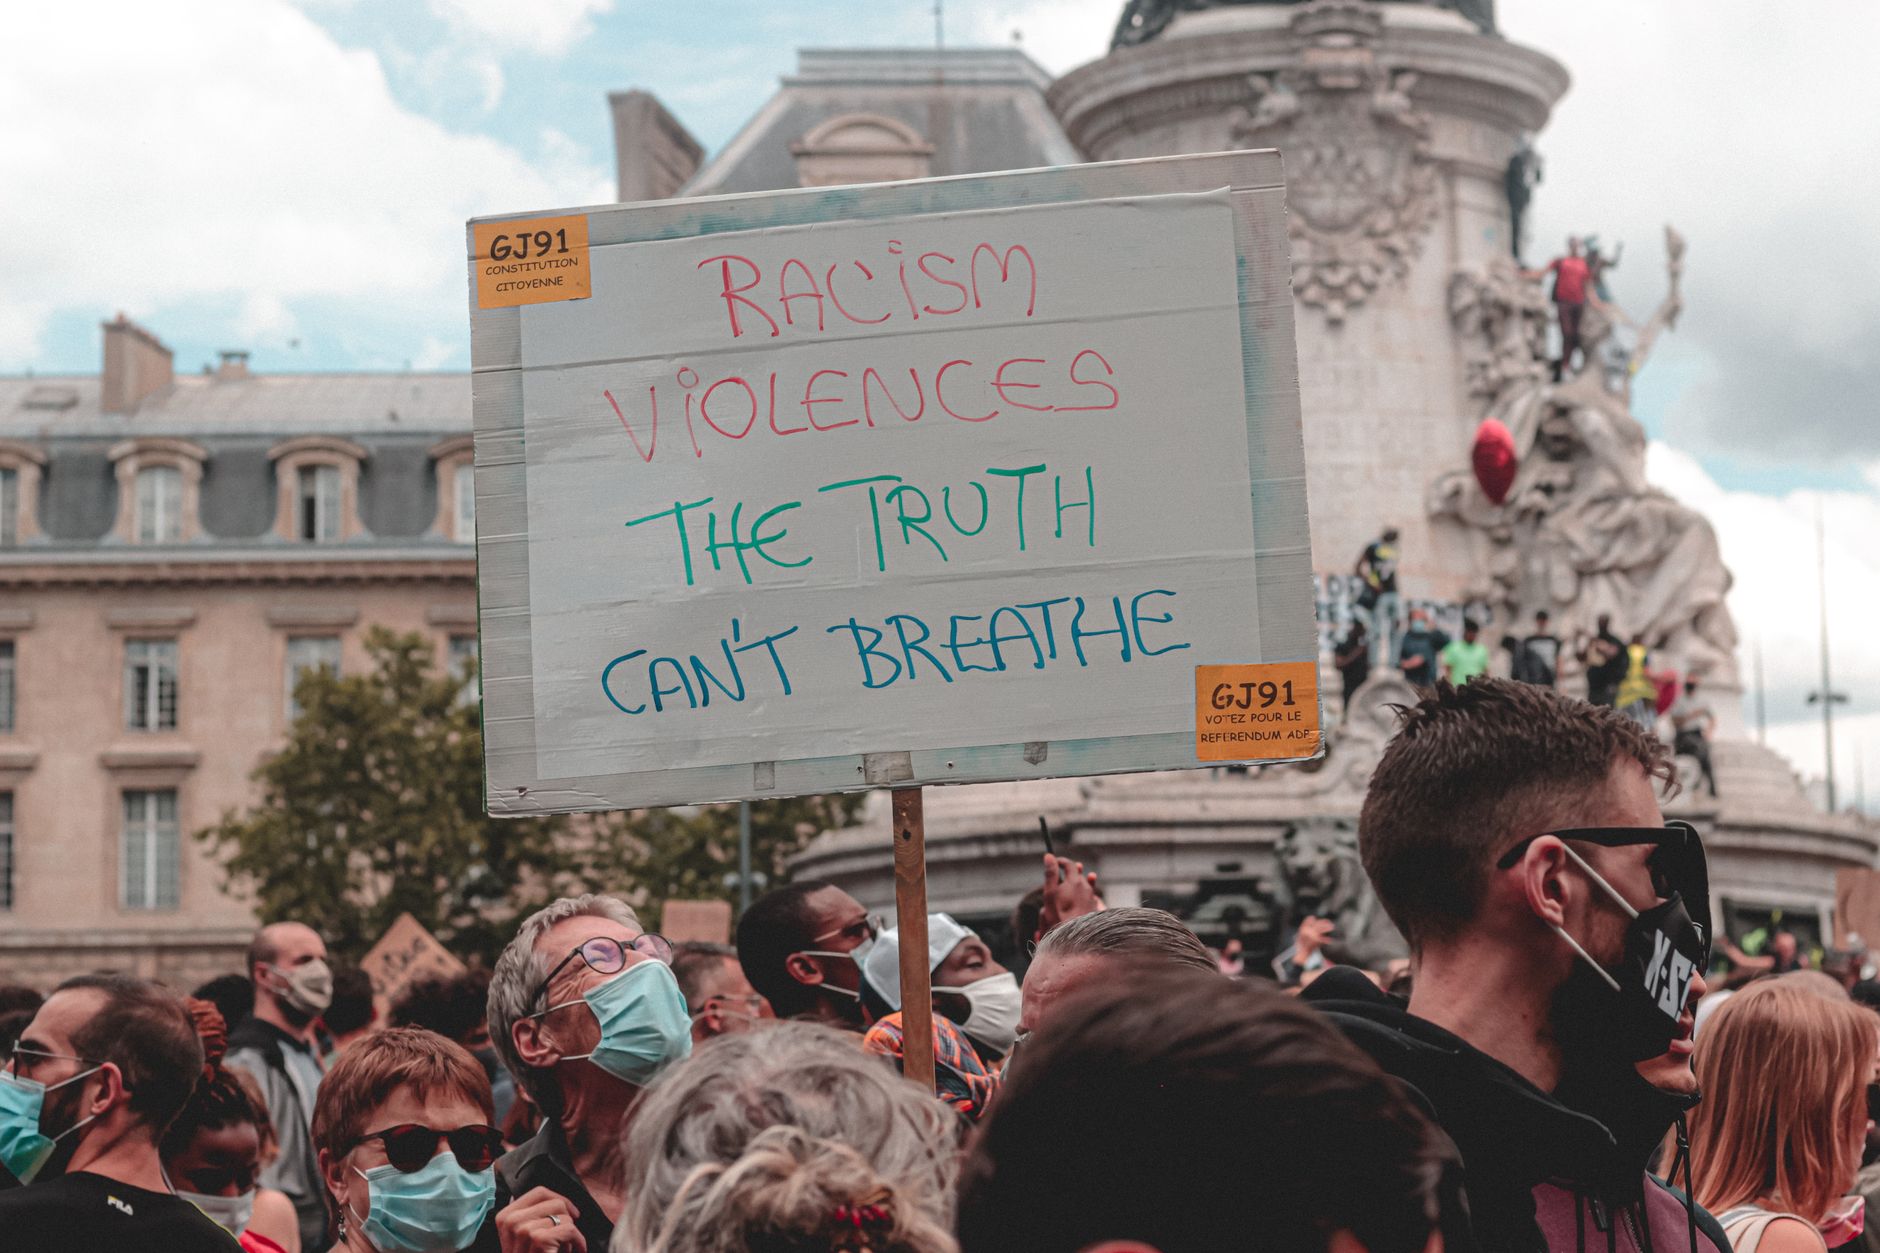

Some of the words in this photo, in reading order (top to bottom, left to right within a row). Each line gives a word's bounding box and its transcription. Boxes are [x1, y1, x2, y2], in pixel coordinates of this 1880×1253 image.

[490, 228, 569, 261] GJ91
[485, 257, 578, 275] CONSTITUTION
[496, 276, 564, 292] CITOYENNE
[625, 497, 813, 586] THE
[818, 463, 1095, 572] TRUTH
[601, 618, 798, 715] CAN'T
[826, 589, 1191, 690] BREATHE
[1211, 680, 1296, 709] GJ91
[1205, 713, 1246, 724] VOTEZ
[1250, 712, 1282, 723] POUR
[1288, 711, 1302, 721] LE
[1200, 731, 1282, 743] REFERENDUM
[1287, 729, 1310, 739] ADP
[107, 1194, 134, 1216] FILA
